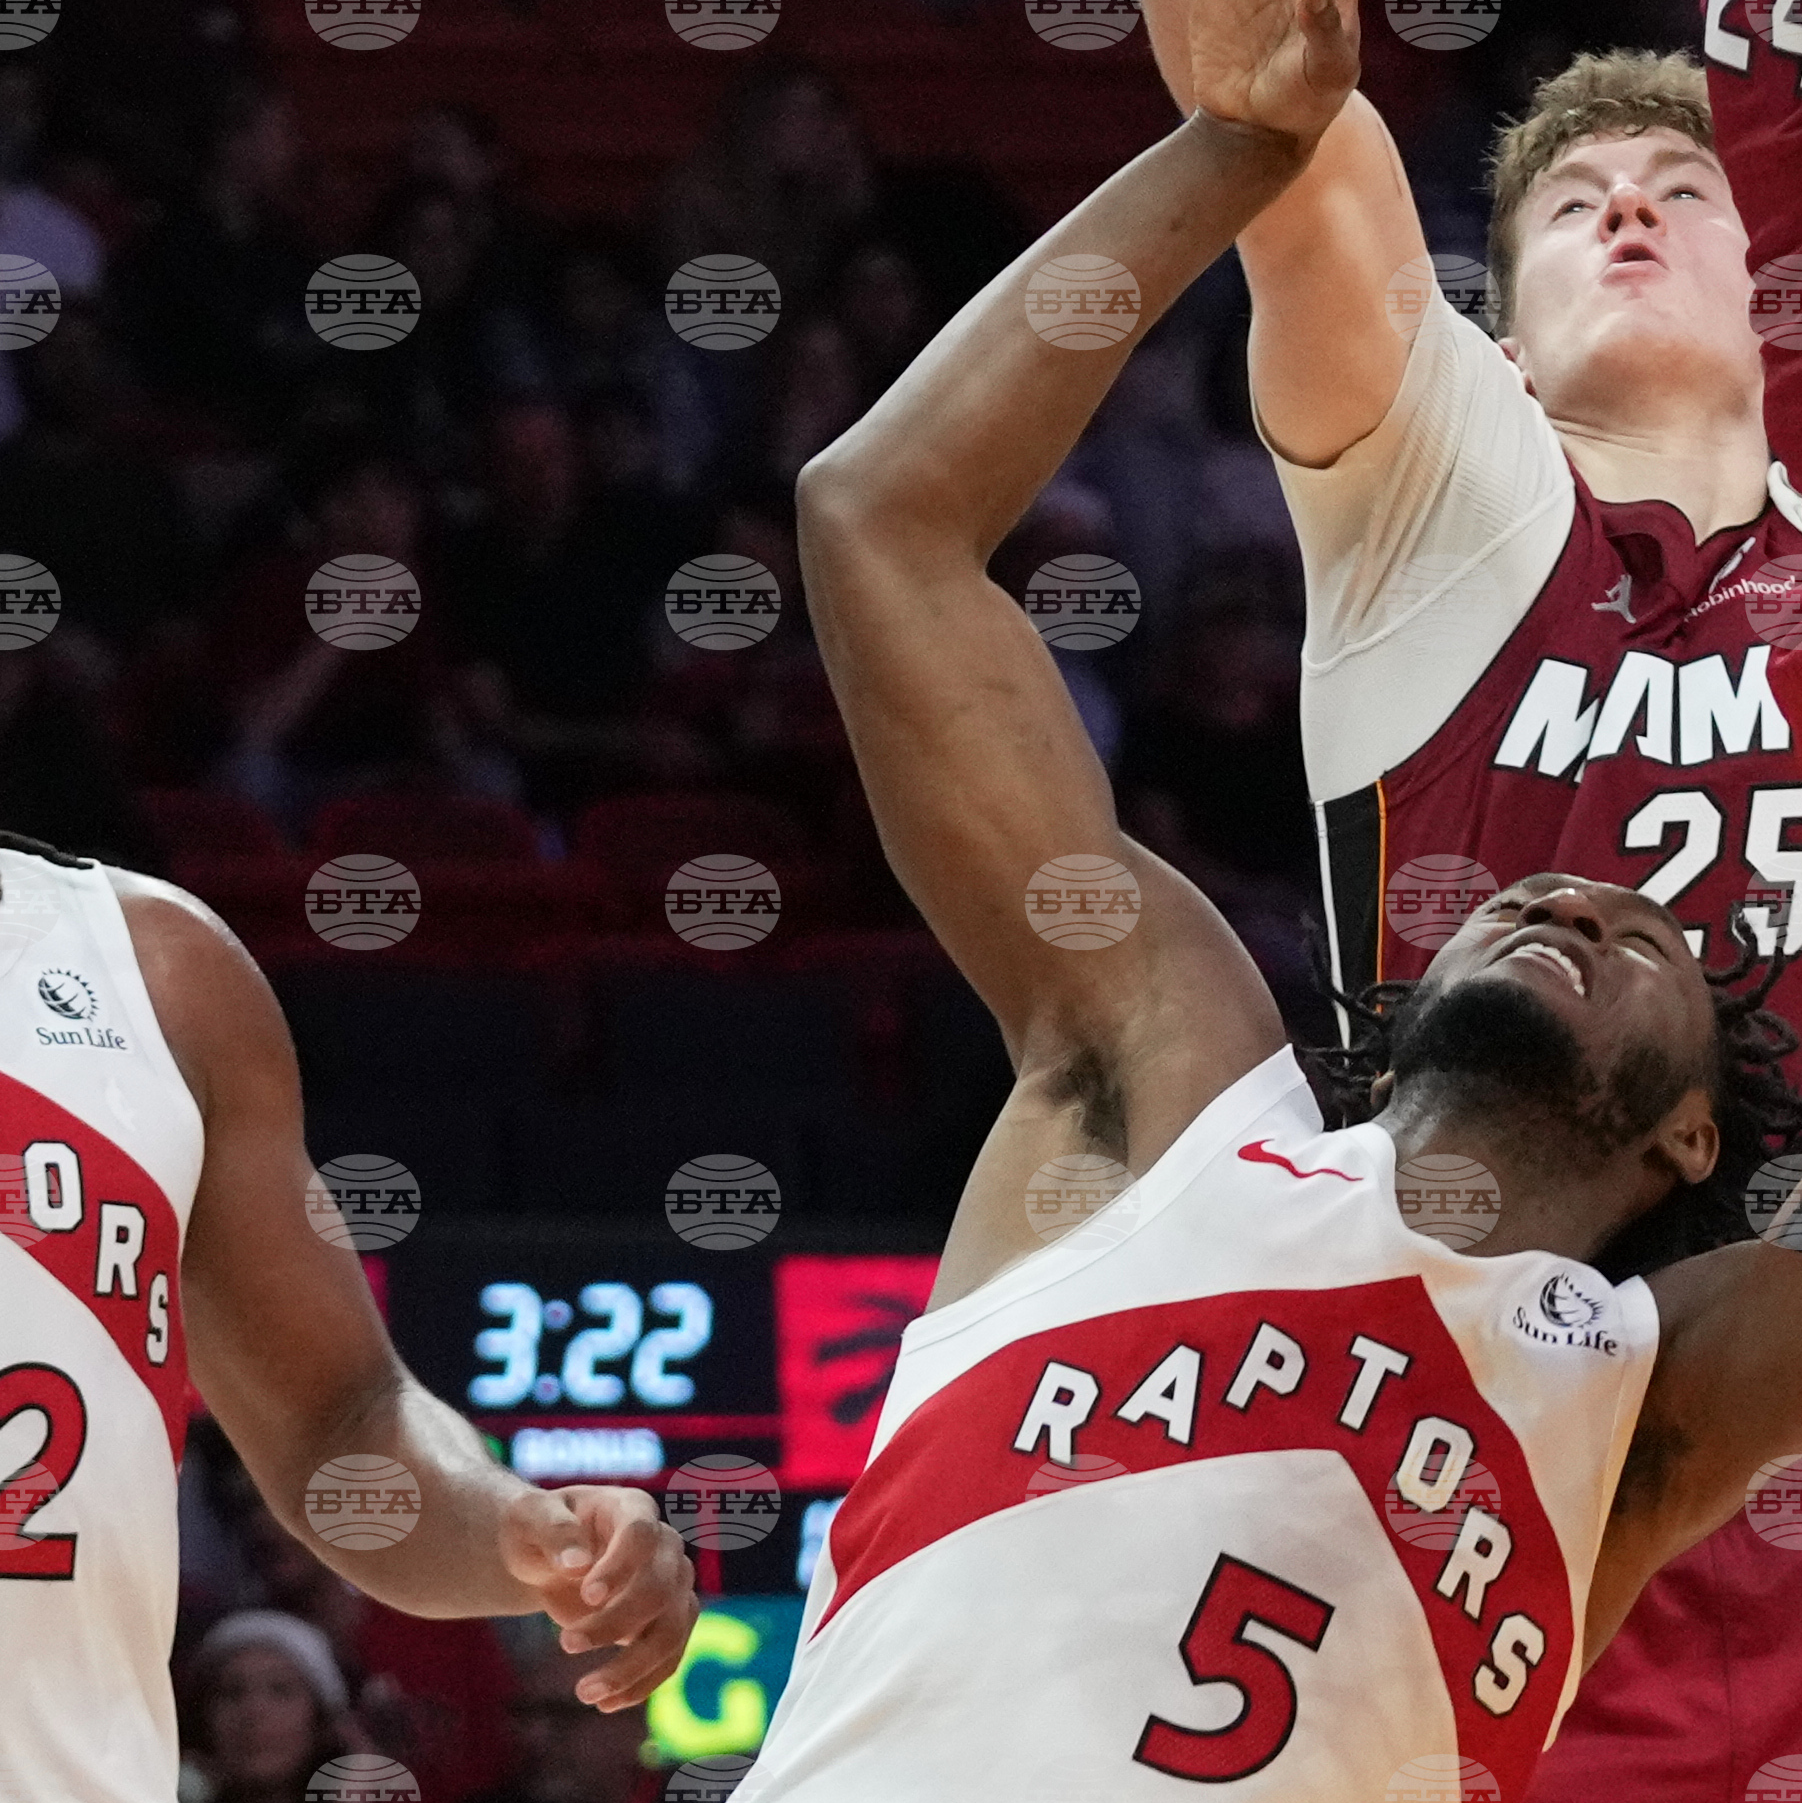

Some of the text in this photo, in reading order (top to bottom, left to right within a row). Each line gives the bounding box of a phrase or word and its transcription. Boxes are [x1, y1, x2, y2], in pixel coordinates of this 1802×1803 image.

[36, 1027, 128, 1051] Sun Life
[468, 1281, 714, 1409] 3:22
[1512, 1305, 1619, 1356] Sun Life
[1013, 1321, 1545, 1718] RAPTORS
[1132, 1551, 1335, 1785] 5
